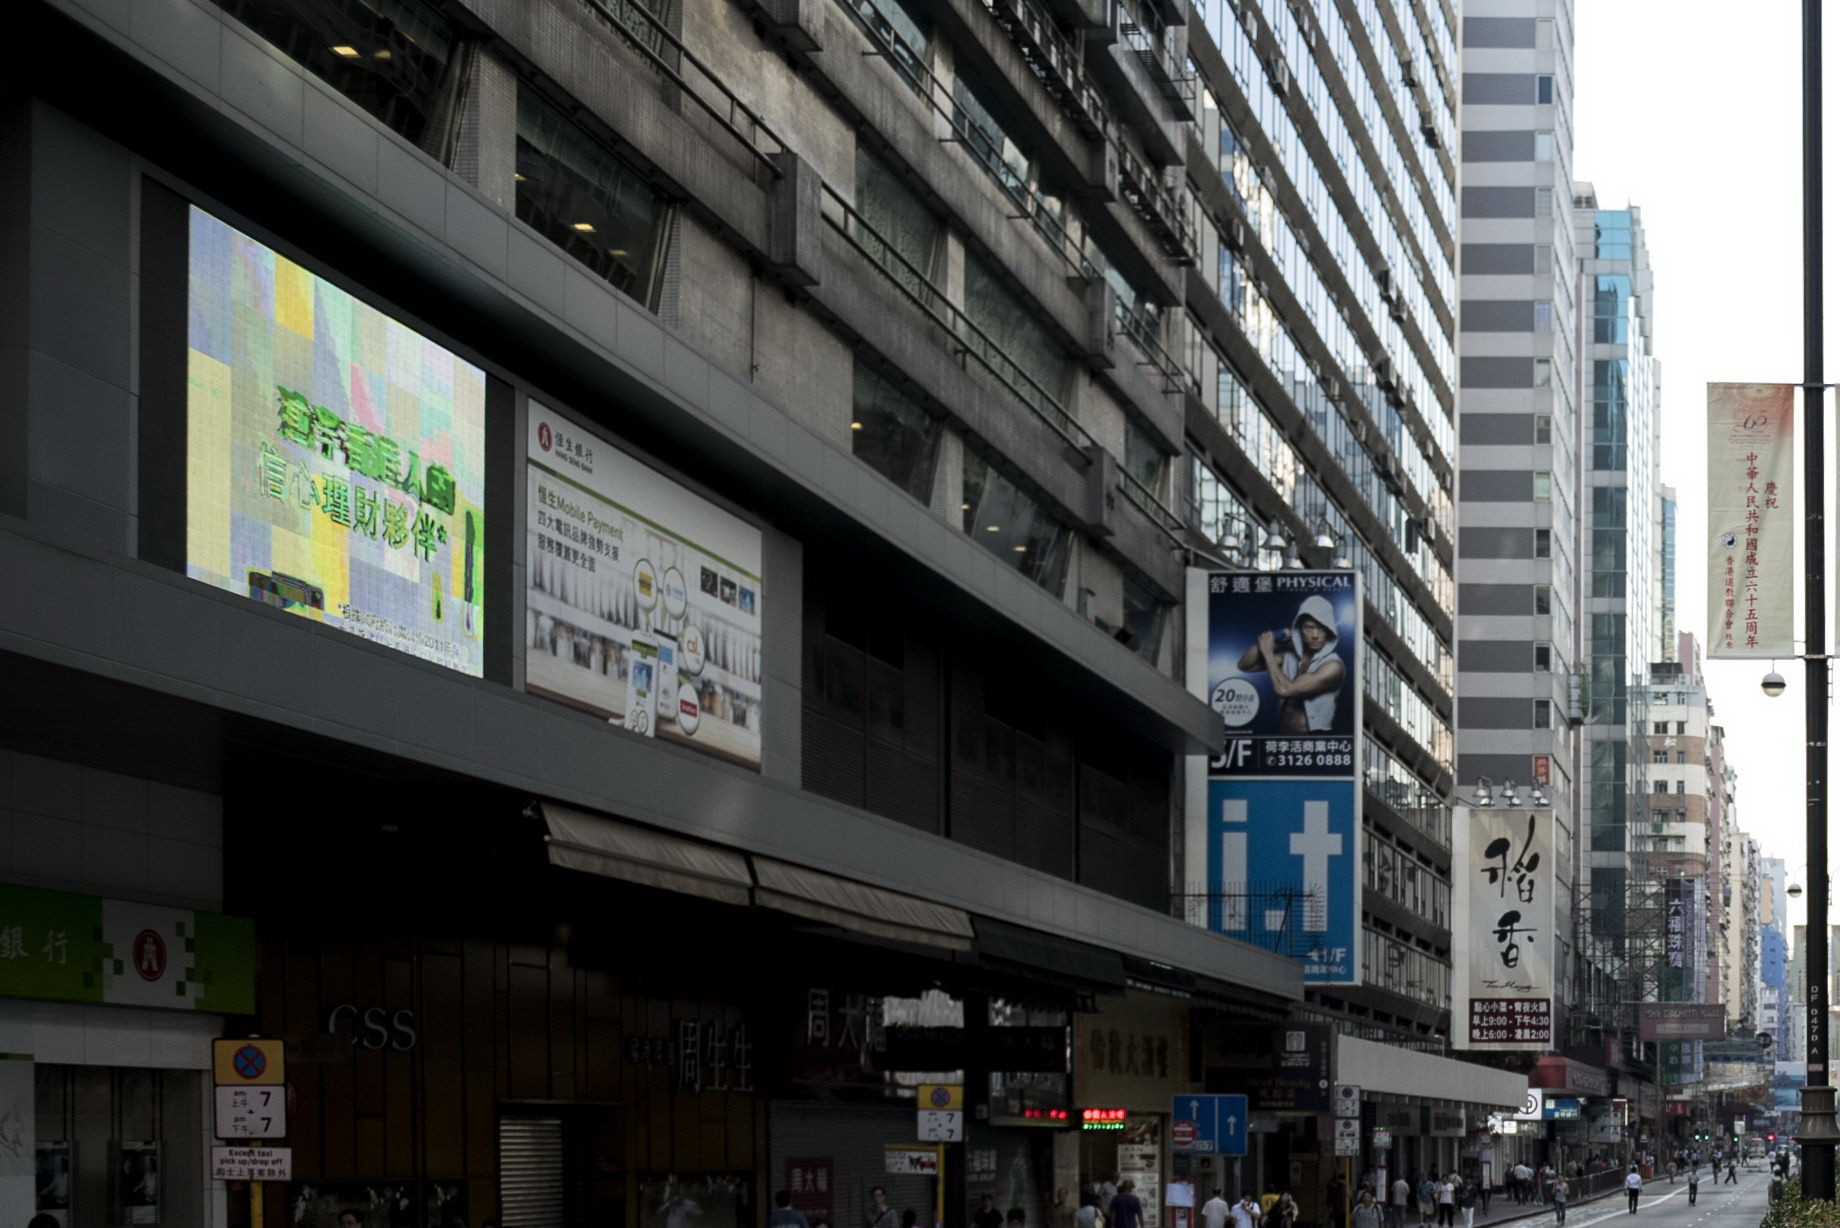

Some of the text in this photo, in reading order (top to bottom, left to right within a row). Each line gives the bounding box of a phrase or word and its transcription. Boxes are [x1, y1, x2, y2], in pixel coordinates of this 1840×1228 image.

[1764, 479, 1779, 510] 慶祝
[587, 511, 623, 543] Payment
[1744, 451, 1760, 650] 中華人民共和國成立六十五周年
[1210, 576, 1351, 593] 舒適堡 PHYSICAL
[1265, 740, 1352, 753] 荷李活商業中心
[1278, 754, 1351, 766] 3126 0888
[1222, 800, 1343, 932] i.t
[0, 925, 70, 966] 銀行
[328, 1004, 417, 1052] CSS
[679, 1019, 755, 1094] 周生生
[260, 1091, 271, 1107] 7
[260, 1117, 272, 1133] 7
[220, 1158, 284, 1168] pick up/drop off
[229, 1149, 272, 1159] Except taxi
